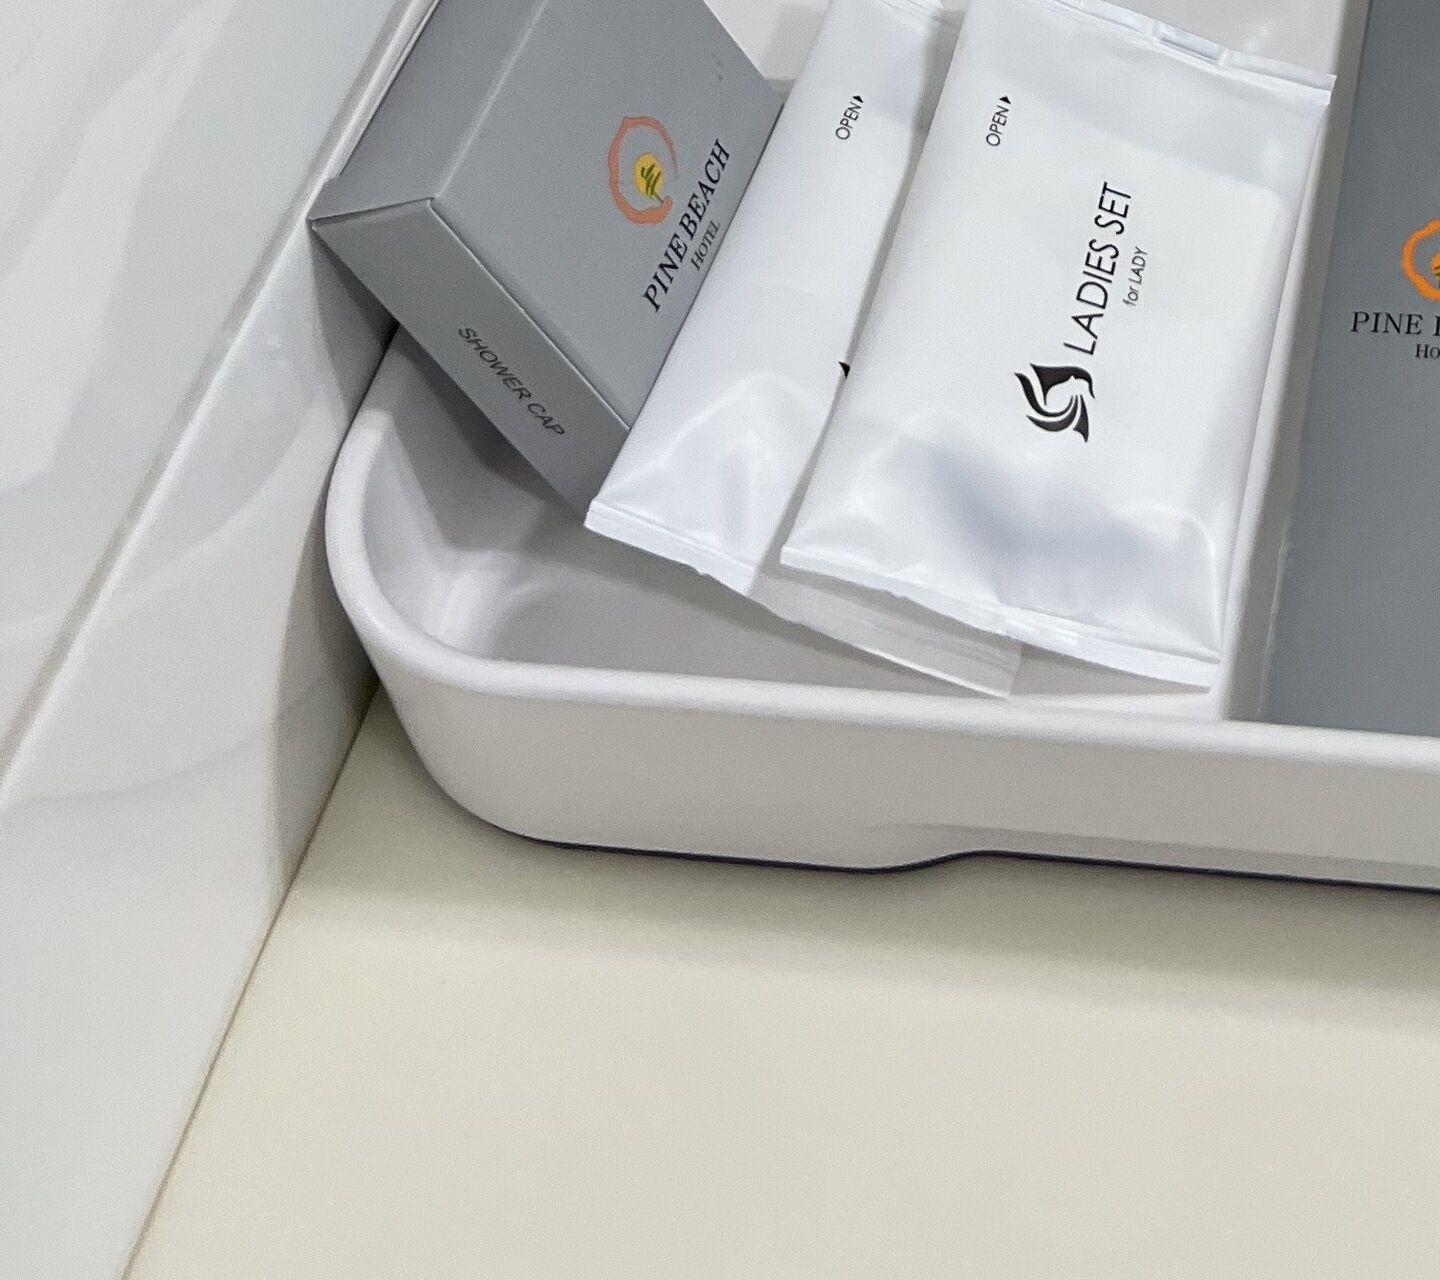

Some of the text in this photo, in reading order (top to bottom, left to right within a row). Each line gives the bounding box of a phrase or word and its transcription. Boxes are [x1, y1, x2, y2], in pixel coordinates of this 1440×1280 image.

[835, 101, 862, 141] OPEN
[985, 105, 1009, 147] OPEN
[642, 138, 731, 313] PINE BEACH
[690, 220, 721, 272] HOTEL
[1063, 181, 1132, 356] LADIES SET
[1122, 245, 1149, 307] for LADY
[1350, 310, 1424, 335] PINE
[458, 327, 565, 435] SHOWER CAP
